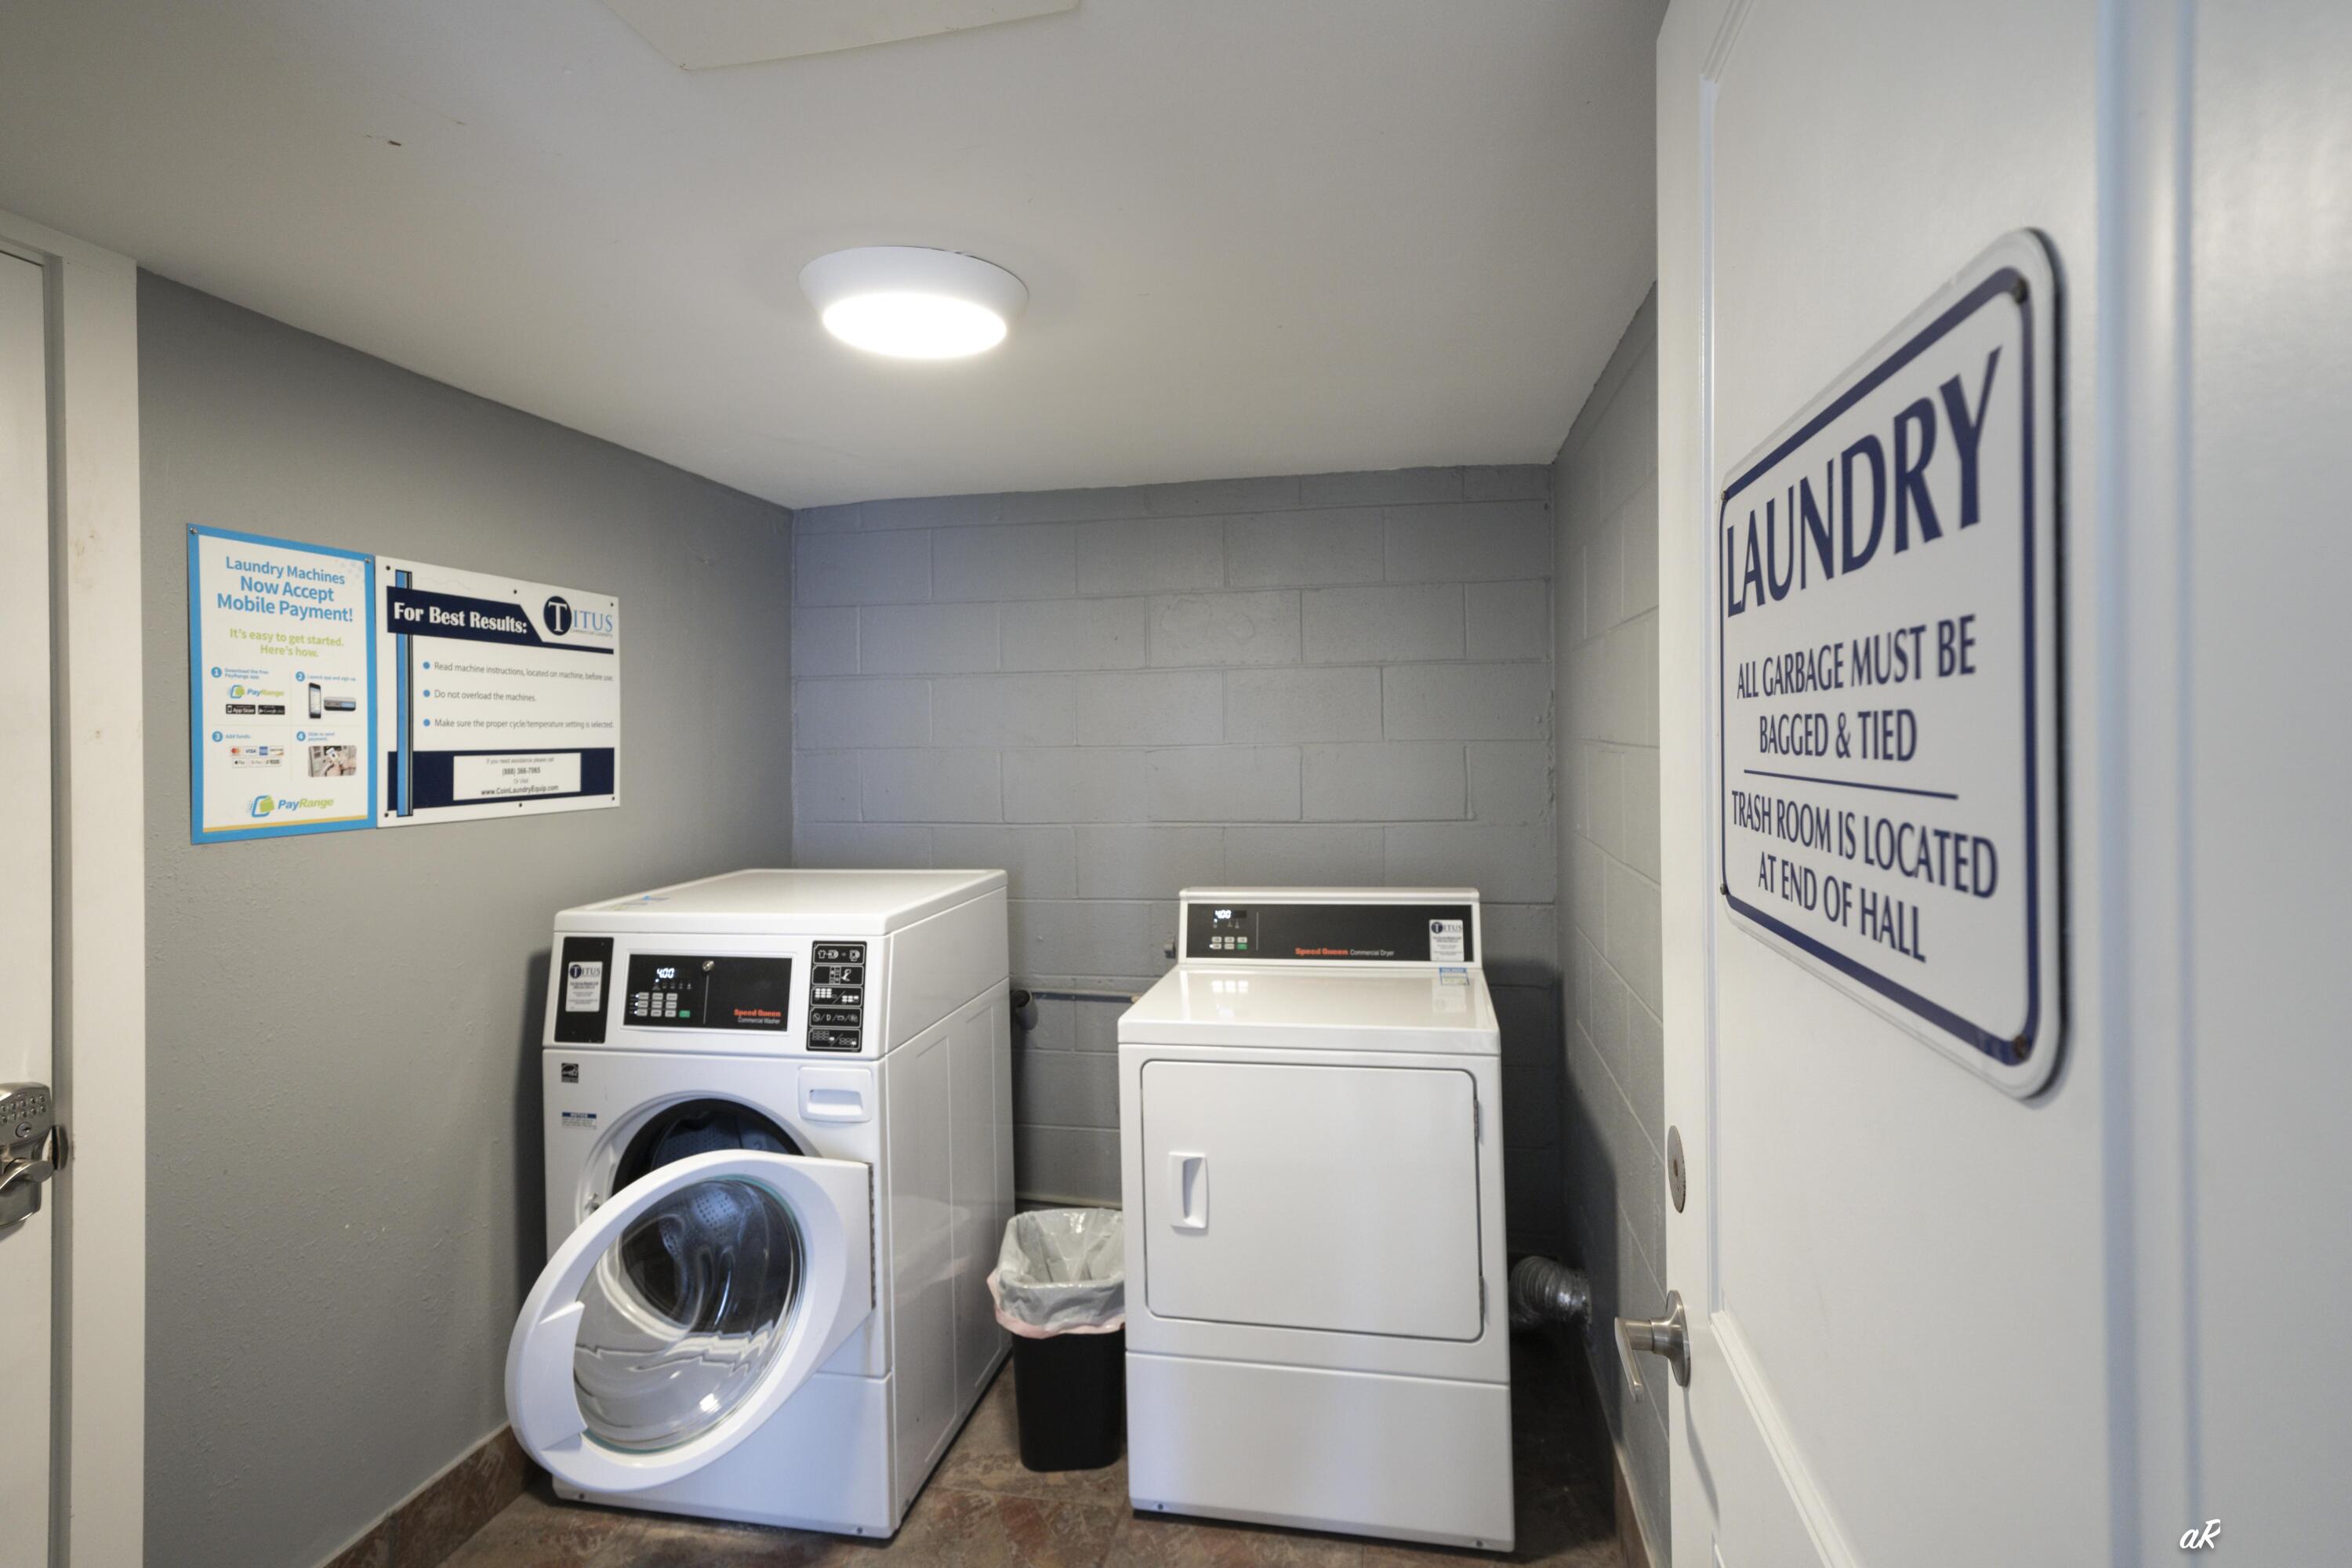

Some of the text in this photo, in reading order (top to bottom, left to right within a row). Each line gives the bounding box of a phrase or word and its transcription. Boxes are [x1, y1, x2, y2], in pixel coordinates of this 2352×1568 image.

[1727, 344, 2002, 618] LAUNDRY
[226, 556, 345, 585] Laundry Machines
[240, 575, 334, 604] Now Accept
[217, 593, 353, 622] Mobile Payment!
[548, 601, 613, 633] TITUS
[394, 602, 528, 633] For Best Results:
[230, 628, 344, 647] It's easy to get started.
[260, 644, 319, 658] Here's how.
[1737, 613, 1976, 699] ALL GARBAGE MUST BE
[434, 662, 453, 671] Read
[455, 665, 485, 673] machine
[486, 666, 525, 676] instructions,
[526, 668, 549, 677] located
[558, 670, 584, 681] machine,
[585, 672, 602, 681] before
[247, 688, 284, 697] PayRange
[434, 689, 445, 698] Do
[461, 691, 492, 700] overload
[506, 693, 537, 702] machines.
[434, 719, 455, 728] Make
[473, 719, 485, 728] the
[486, 720, 508, 729] proper
[509, 719, 564, 729] cycle/temperature
[564, 720, 585, 729] setting
[590, 720, 615, 728] selected.
[1759, 708, 1918, 762] BAGGED & TIED
[481, 785, 559, 796] www.CoinLaundryEquip.com
[278, 798, 334, 811] PayRange
[1731, 790, 1998, 899] TRASH ROOM IS LOCATED
[1758, 851, 1926, 964] AT END OF HALL
[1295, 947, 1321, 956] Speed
[1322, 947, 1348, 956] Queen
[571, 966, 601, 977] TITUS
[734, 1008, 757, 1018] Speed
